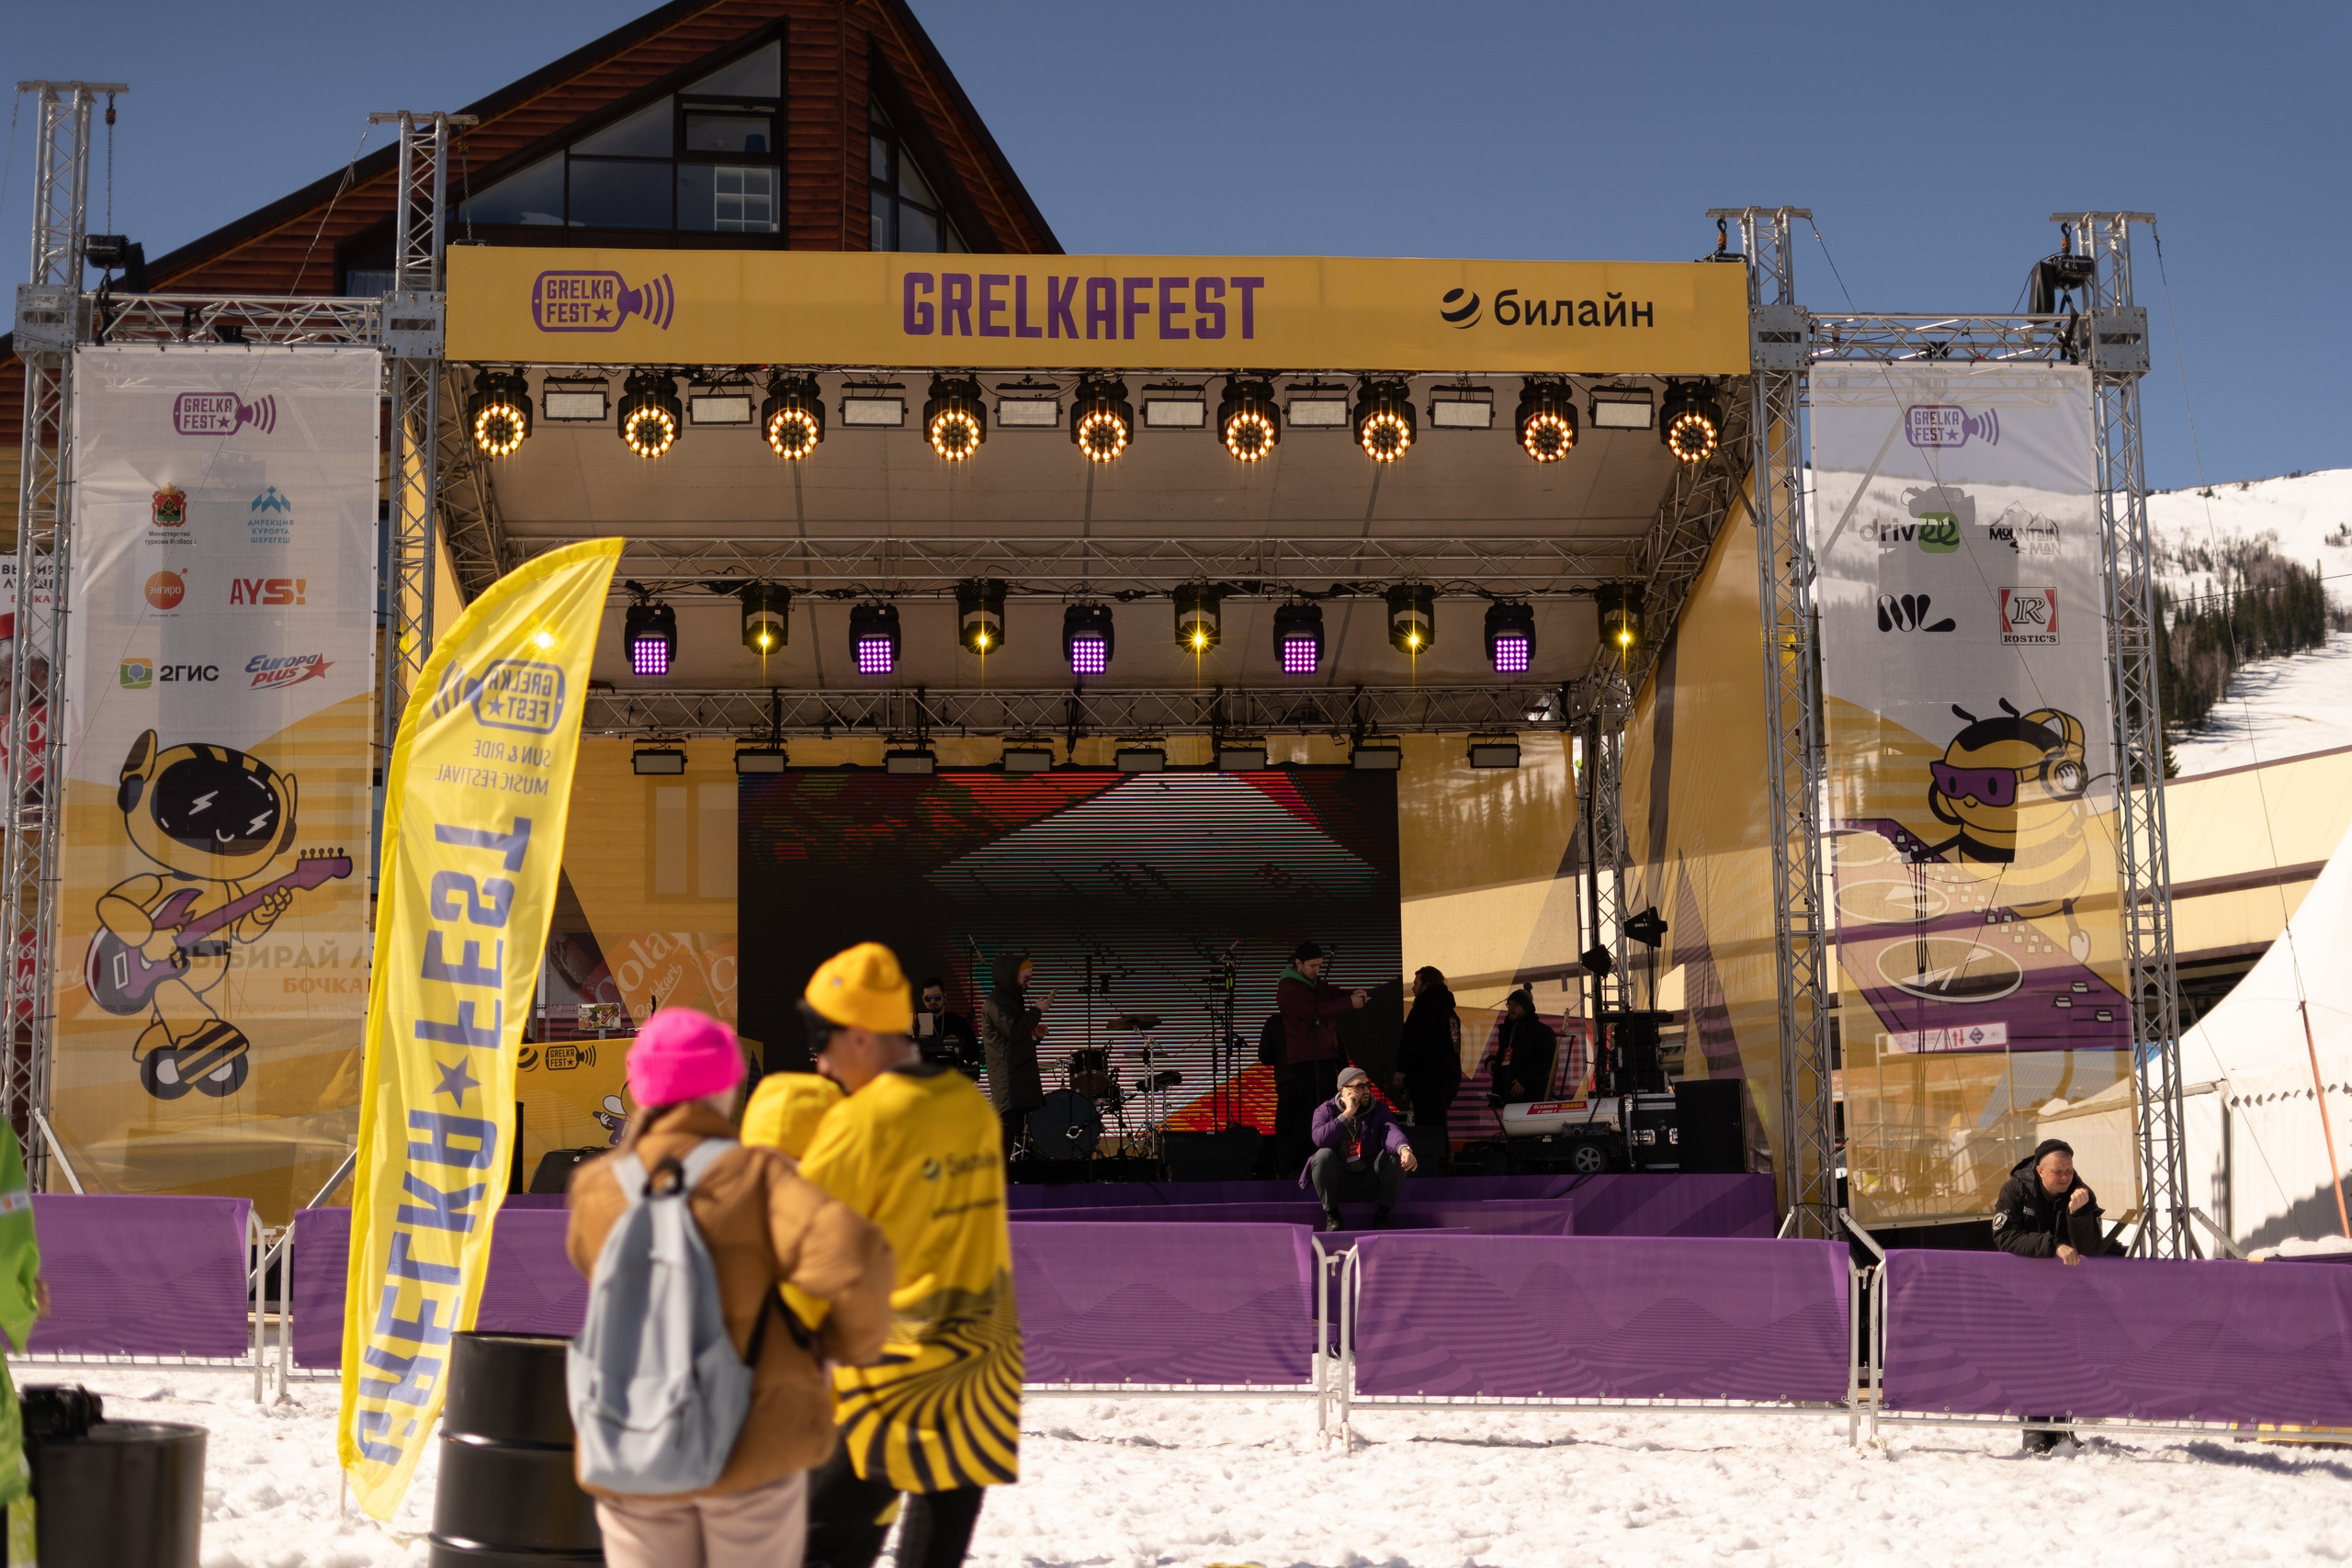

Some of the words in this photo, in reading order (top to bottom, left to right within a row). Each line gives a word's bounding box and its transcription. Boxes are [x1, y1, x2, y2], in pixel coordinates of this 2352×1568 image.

[546, 278, 614, 300] GRELKA
[546, 302, 592, 323] FEST
[902, 272, 1265, 339] GRELKAFEST
[1494, 288, 1654, 329] билайн
[184, 398, 232, 413] GRELKA
[183, 413, 216, 430] FEST
[1914, 411, 1960, 426] GRELKA
[1915, 427, 1946, 442] FEST
[247, 519, 294, 527] ДИРЕКЦИЯ
[2030, 542, 2062, 555] MAN
[149, 585, 182, 597] энгиро
[230, 578, 306, 605] AYS!
[2003, 634, 2057, 644] ROSTIC'S
[160, 664, 220, 682] 2ГИС
[549, 1048, 575, 1058] GRELKA
[550, 1058, 568, 1067] FEST
